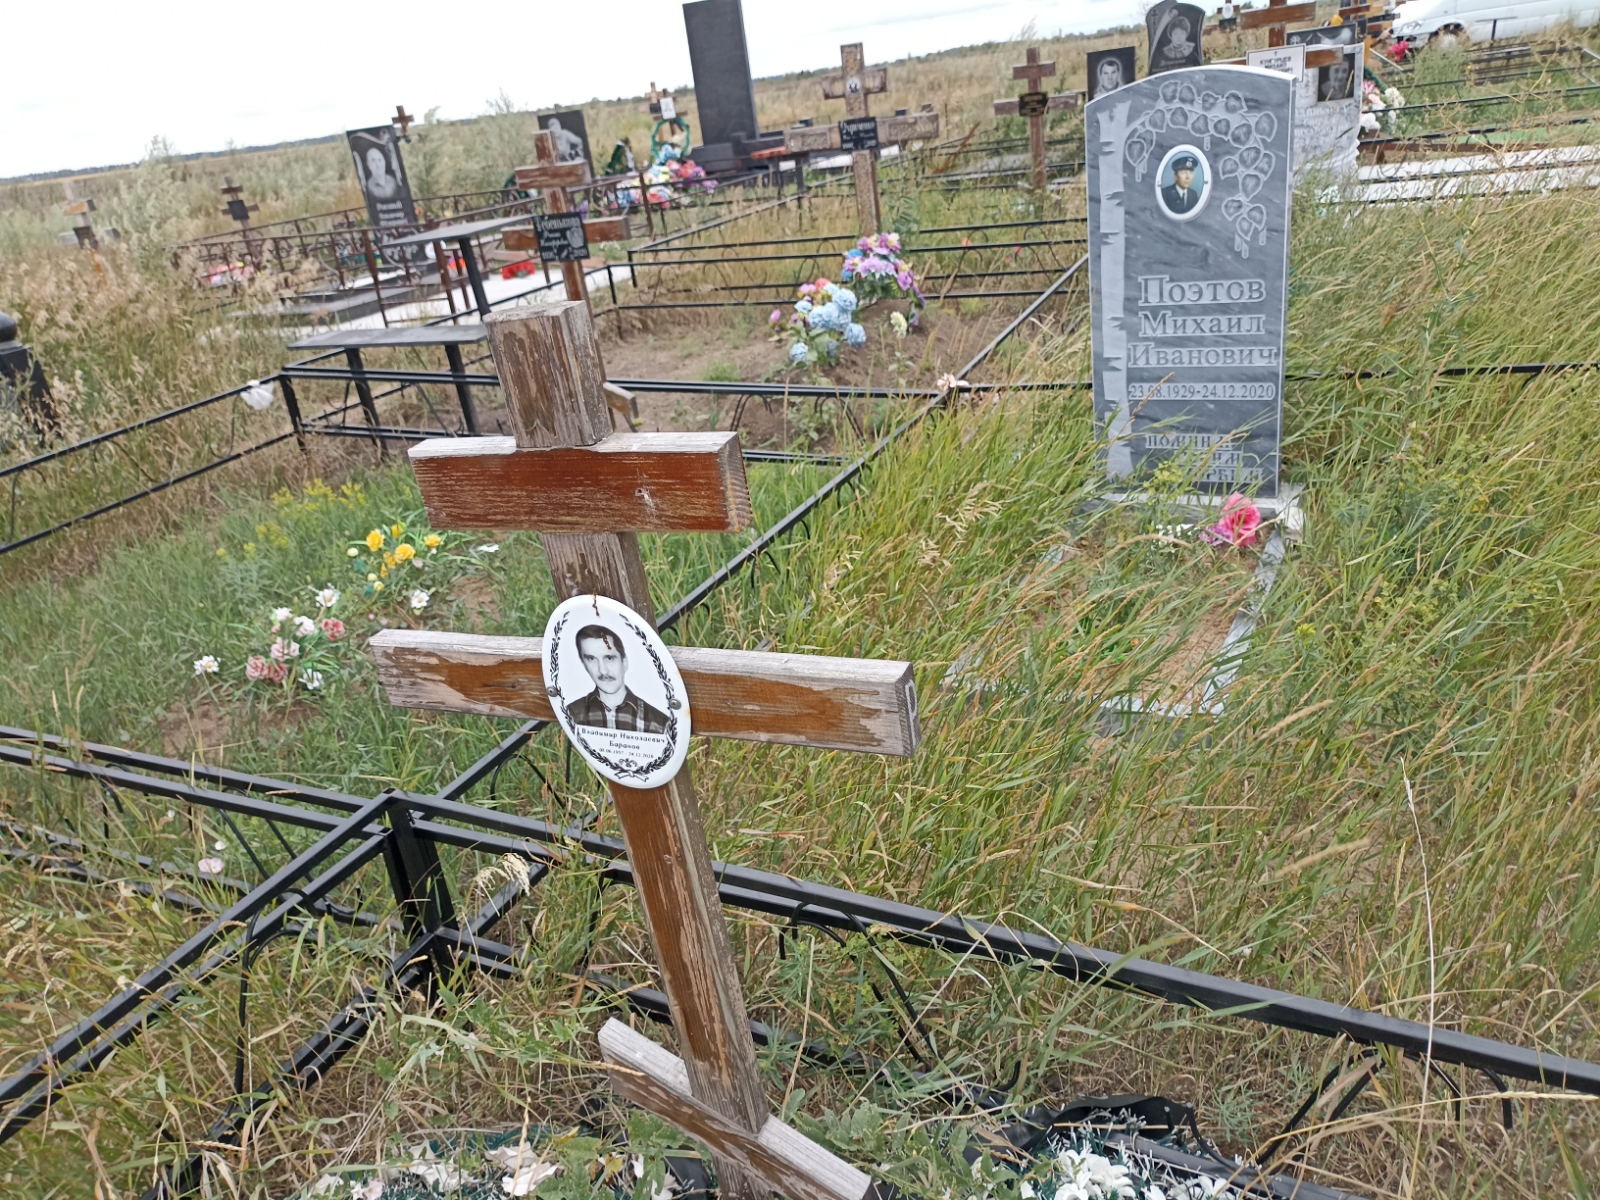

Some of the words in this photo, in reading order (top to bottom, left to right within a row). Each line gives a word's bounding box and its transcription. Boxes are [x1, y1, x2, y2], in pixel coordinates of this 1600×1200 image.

[1139, 276, 1265, 305] Поэтов
[1140, 312, 1265, 336] Михаил
[1130, 344, 1276, 367] Иванович
[620, 732, 665, 743] Николаевич
